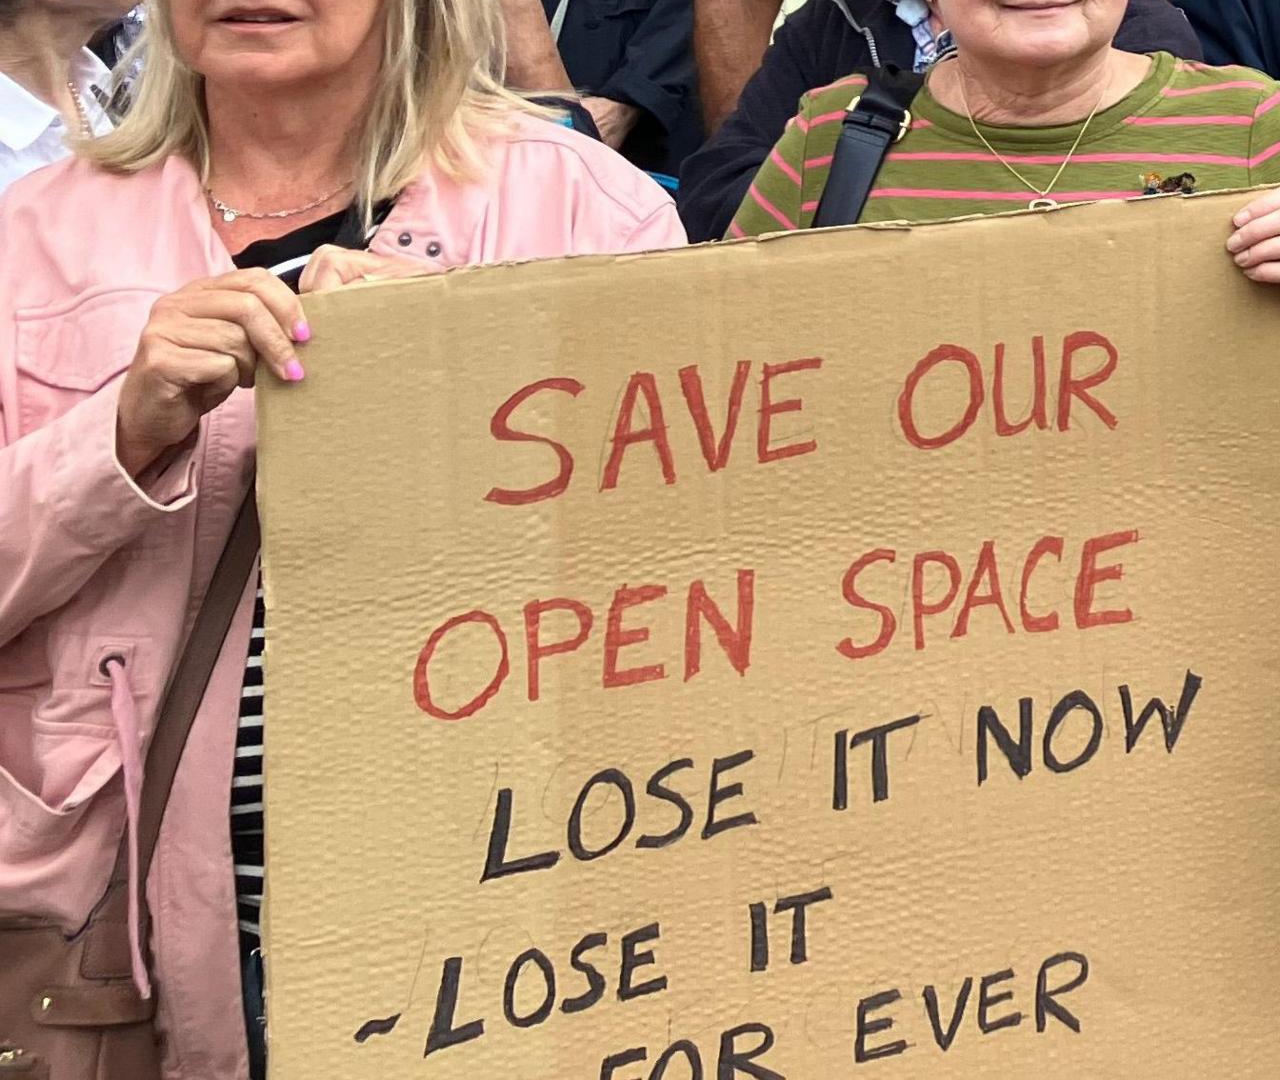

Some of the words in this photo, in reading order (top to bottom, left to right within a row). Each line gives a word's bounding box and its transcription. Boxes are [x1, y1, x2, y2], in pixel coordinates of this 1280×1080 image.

[484, 356, 823, 506] SAVE
[897, 330, 1119, 451] OUR
[412, 568, 755, 721] OPEN
[835, 529, 1139, 661] SPACE
[479, 749, 758, 884] LOSE
[831, 712, 924, 812] IT
[977, 669, 1203, 788] NOW
[600, 1022, 787, 1080] FOR
[854, 951, 1090, 1063] EVER
[749, 886, 833, 973] IT
